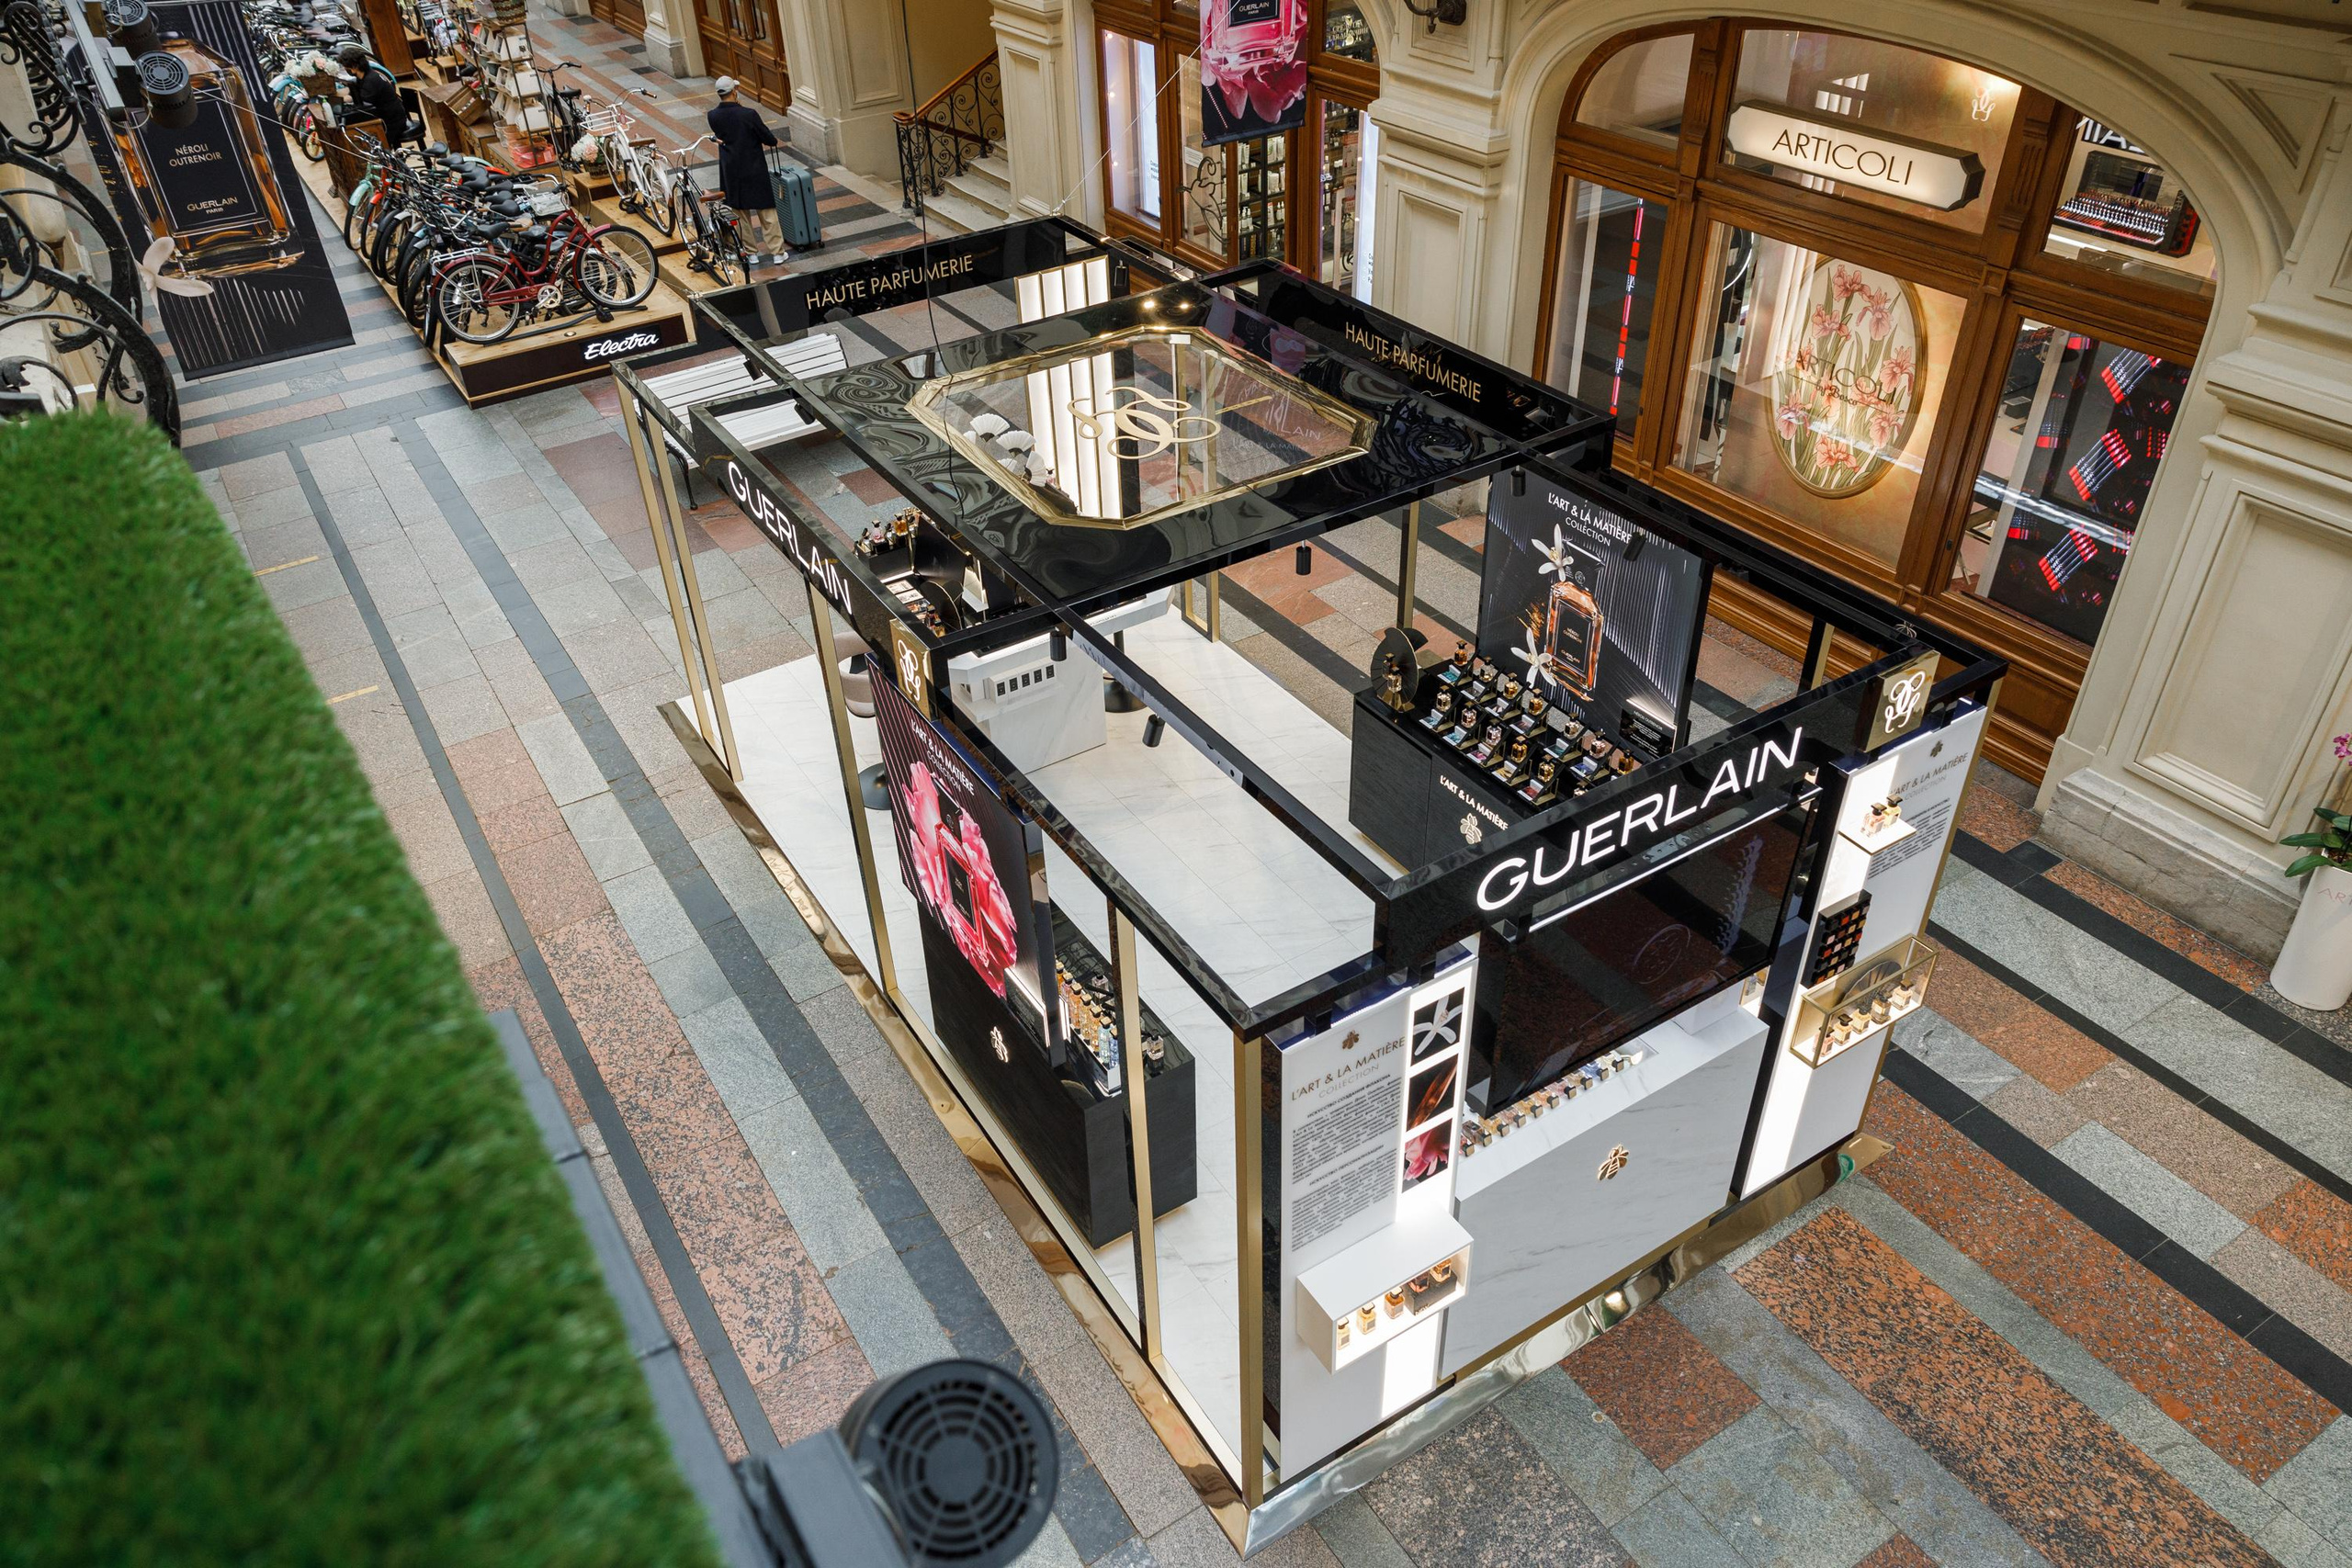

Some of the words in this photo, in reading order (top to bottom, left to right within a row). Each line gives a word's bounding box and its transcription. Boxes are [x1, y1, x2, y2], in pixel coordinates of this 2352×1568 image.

[1238, 2, 1270, 12] GUERLAIN
[169, 152, 222, 166] OUTRENOIR
[175, 143, 209, 156] NÉROLI
[1772, 129, 1913, 185] ARTICOLI
[187, 197, 238, 211] GUERLAIN
[806, 280, 866, 310] HAUTE
[870, 254, 974, 295] PARFUMERIE
[583, 333, 660, 360] Electra
[1345, 321, 1389, 359] HAUTE
[1393, 344, 1482, 403] PARFUMERIE
[1795, 350, 1896, 404] ARTICOLI
[1828, 385, 1858, 406] Bosco
[1548, 492, 1570, 512] L'ART
[1570, 505, 1578, 517] &
[1580, 509, 1591, 525] LA
[728, 461, 853, 615] GUERLAIN
[1565, 517, 1611, 547] COLLECTION
[910, 719, 928, 744] L'ART
[928, 738, 934, 752] &
[934, 745, 944, 765] LA
[944, 756, 974, 796] MATIÈRE
[926, 750, 962, 792] COLLECTION
[1911, 777, 1918, 788] &
[1920, 772, 1930, 784] LA
[1932, 752, 1969, 777] MATIÈRE
[1440, 774, 1458, 795] L'ART
[1458, 789, 1465, 800] &
[1465, 794, 1476, 808] LA
[1476, 802, 1509, 831] MATIÈRE
[1476, 727, 1804, 911] GUERLAIN
[1291, 1078, 1321, 1101] L'ART
[1324, 1073, 1334, 1085] &
[1337, 1064, 1351, 1078] LA
[1355, 1036, 1406, 1069] MATIÈRE
[1317, 1064, 1380, 1099] COLLECTION
